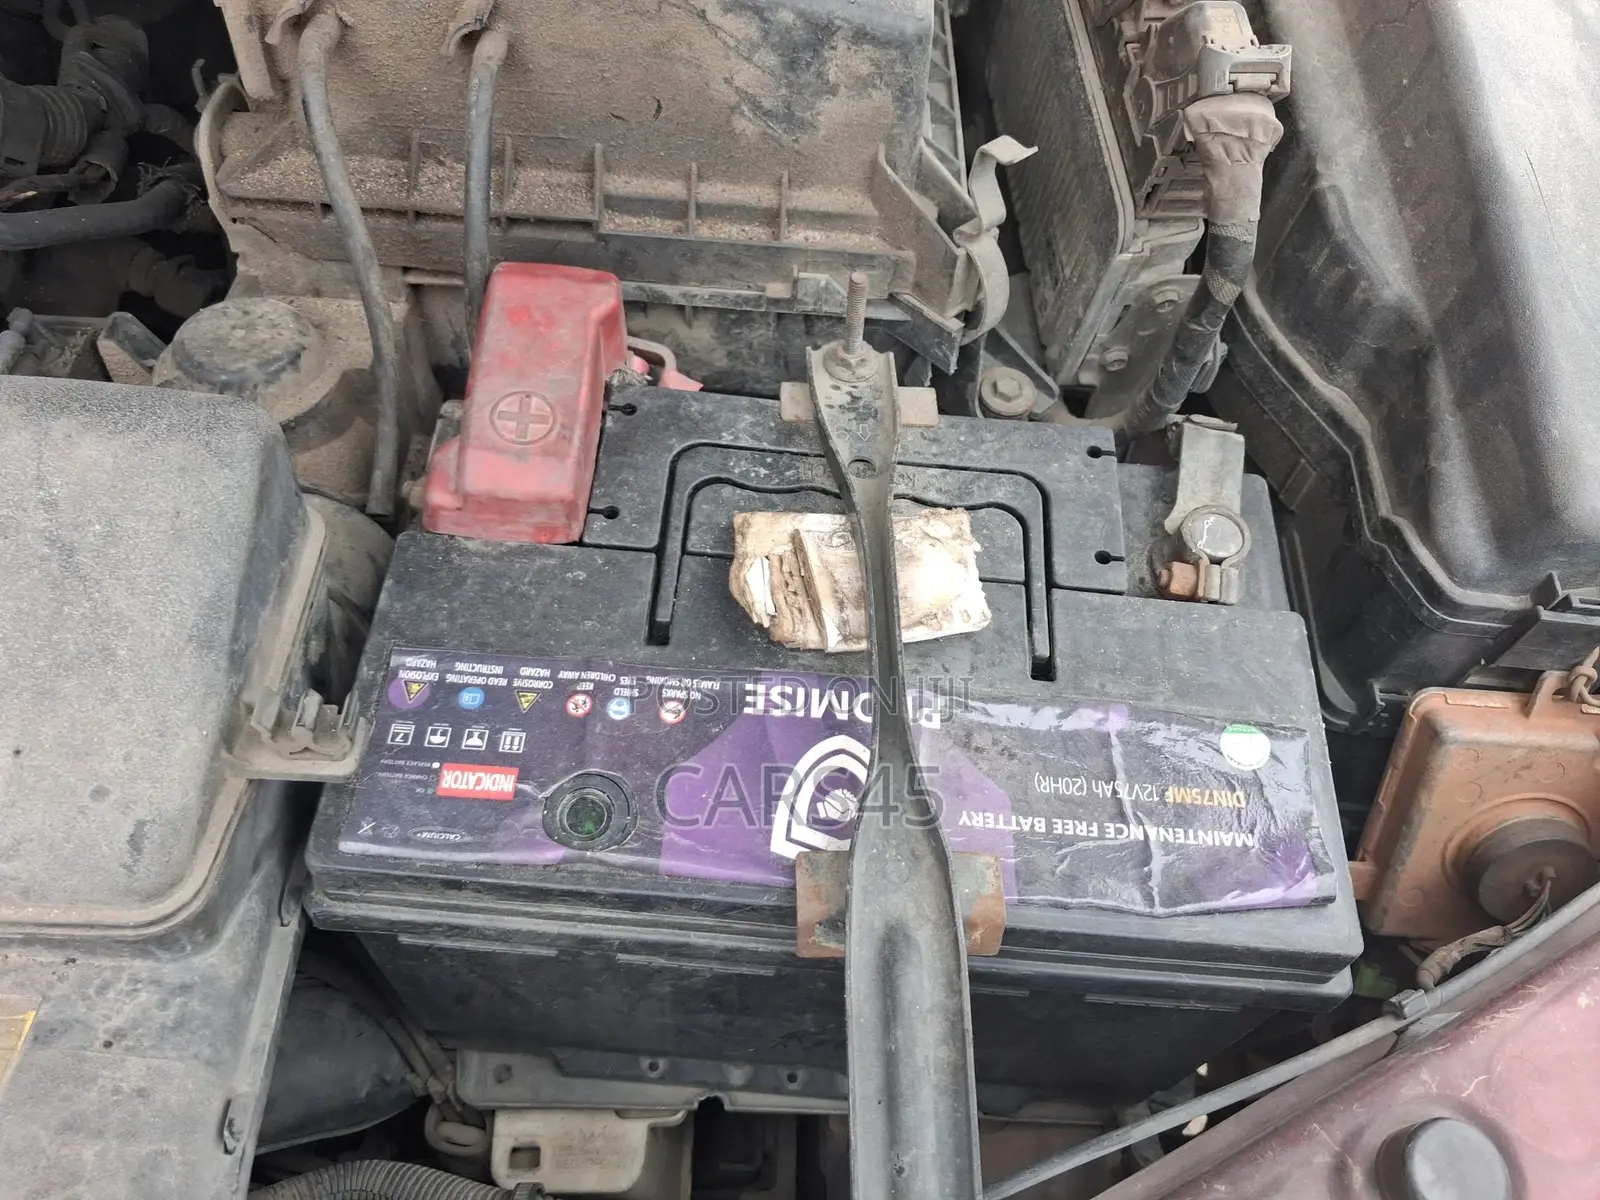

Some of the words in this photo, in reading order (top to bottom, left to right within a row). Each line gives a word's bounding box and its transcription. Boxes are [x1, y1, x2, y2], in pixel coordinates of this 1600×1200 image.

[405, 658, 437, 669] HAZARD
[455, 662, 504, 674] INSTRUCTING
[398, 669, 440, 681] EXPLOSION
[519, 666, 551, 677] HAZARD
[557, 670, 580, 680] AWAY
[581, 671, 617, 682] CHILDREN
[445, 673, 488, 685] OPERATING
[488, 677, 508, 687] READ
[513, 677, 554, 690] CORROSIVE
[662, 688, 689, 699] SPARKS
[690, 690, 702, 700] NO
[441, 770, 515, 792] INDICATOR
[1034, 771, 1088, 797] (20HR)
[1165, 785, 1246, 809] DIN75MF
[958, 810, 1046, 834] BATTERY
[1051, 817, 1099, 838] FREE
[1104, 822, 1254, 849] MAINTENANCE
